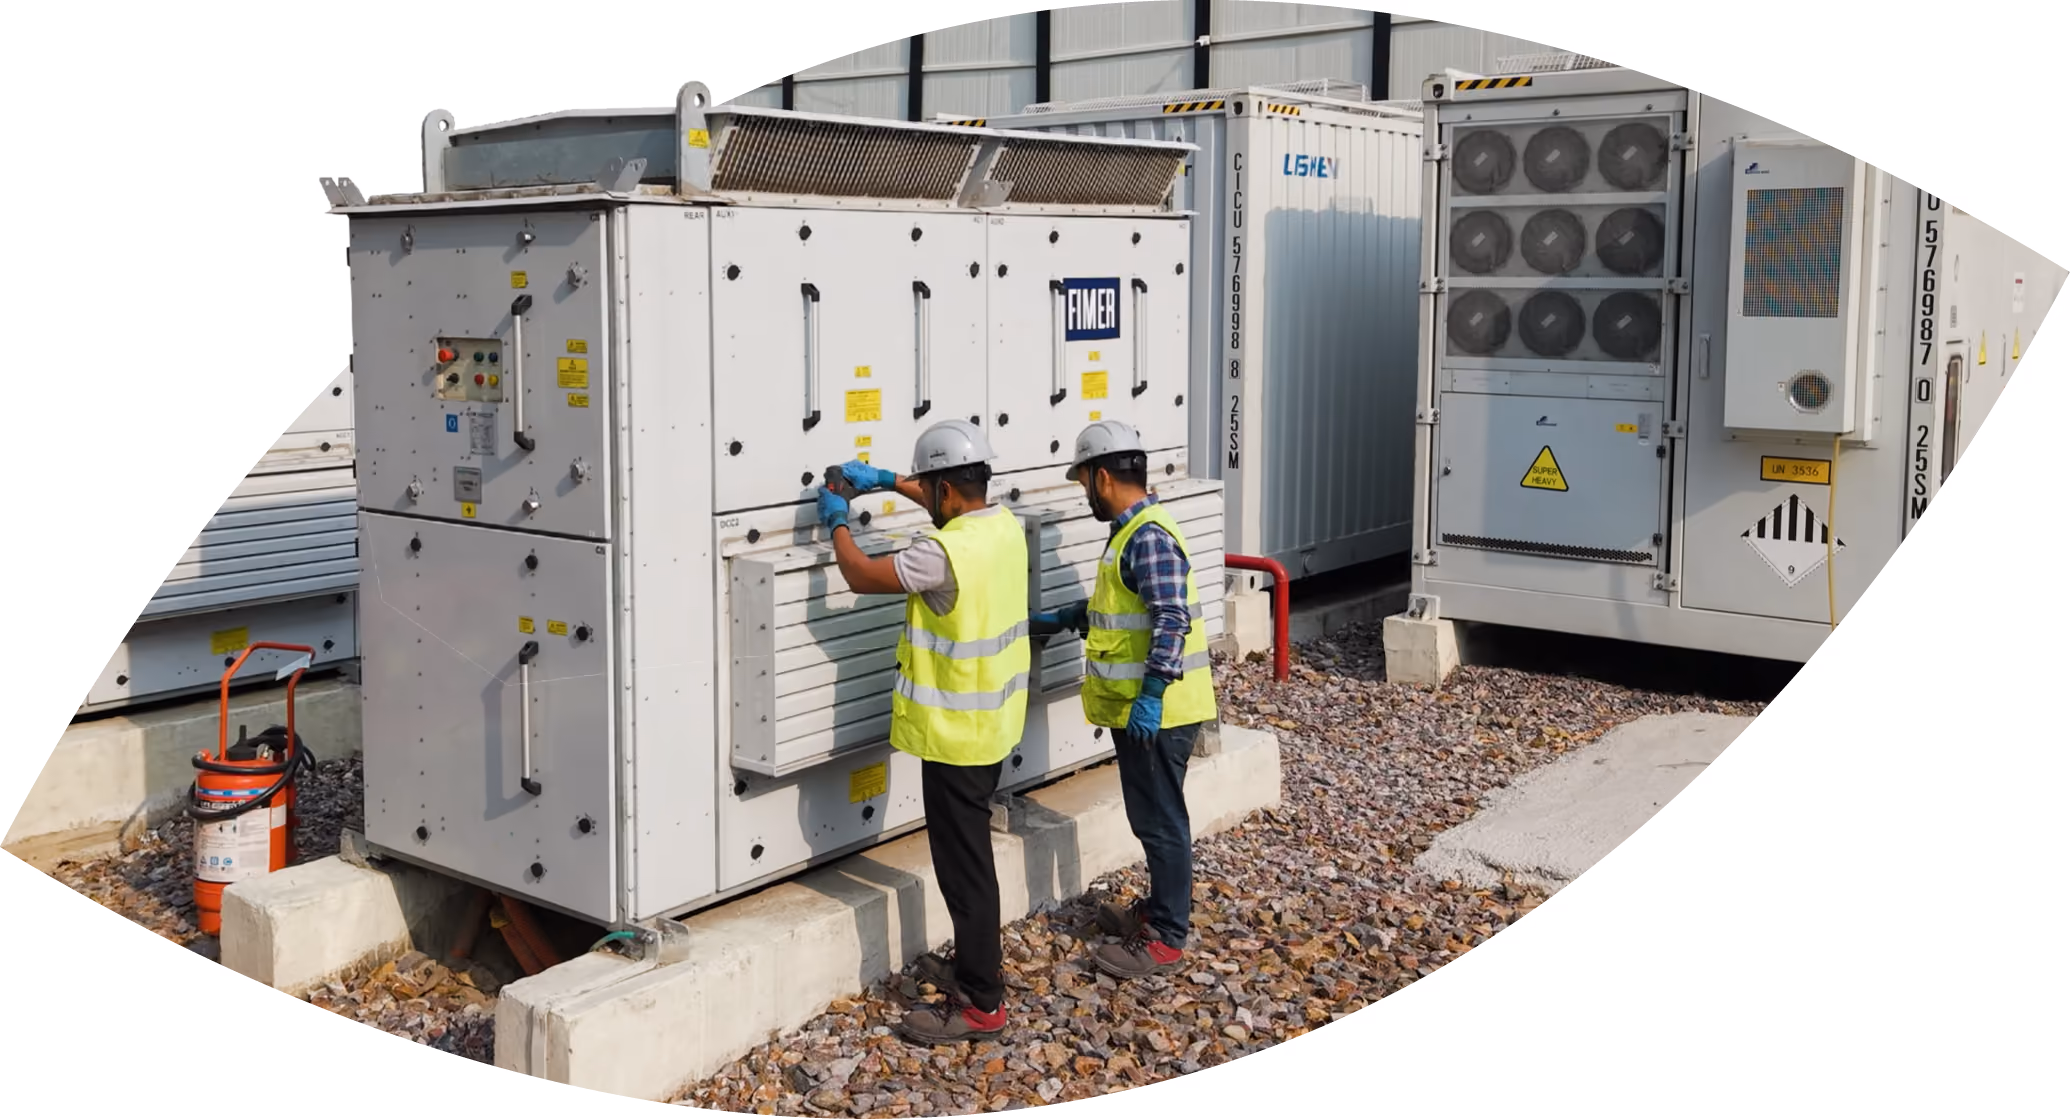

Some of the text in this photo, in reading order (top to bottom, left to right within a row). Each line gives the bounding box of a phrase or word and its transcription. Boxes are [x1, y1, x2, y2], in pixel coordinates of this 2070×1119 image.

[684, 211, 705, 220] REAR
[1919, 220, 1938, 366] 576987
[1067, 288, 1115, 330] FIMER
[1228, 152, 1242, 469] CICU 576998 8 25SM
[1532, 465, 1558, 476] SUPER
[1772, 464, 1819, 477] UN 3536
[1911, 424, 1929, 519] 25SM
[1531, 476, 1557, 486] HEAVY
[1788, 565, 1795, 574] 9
